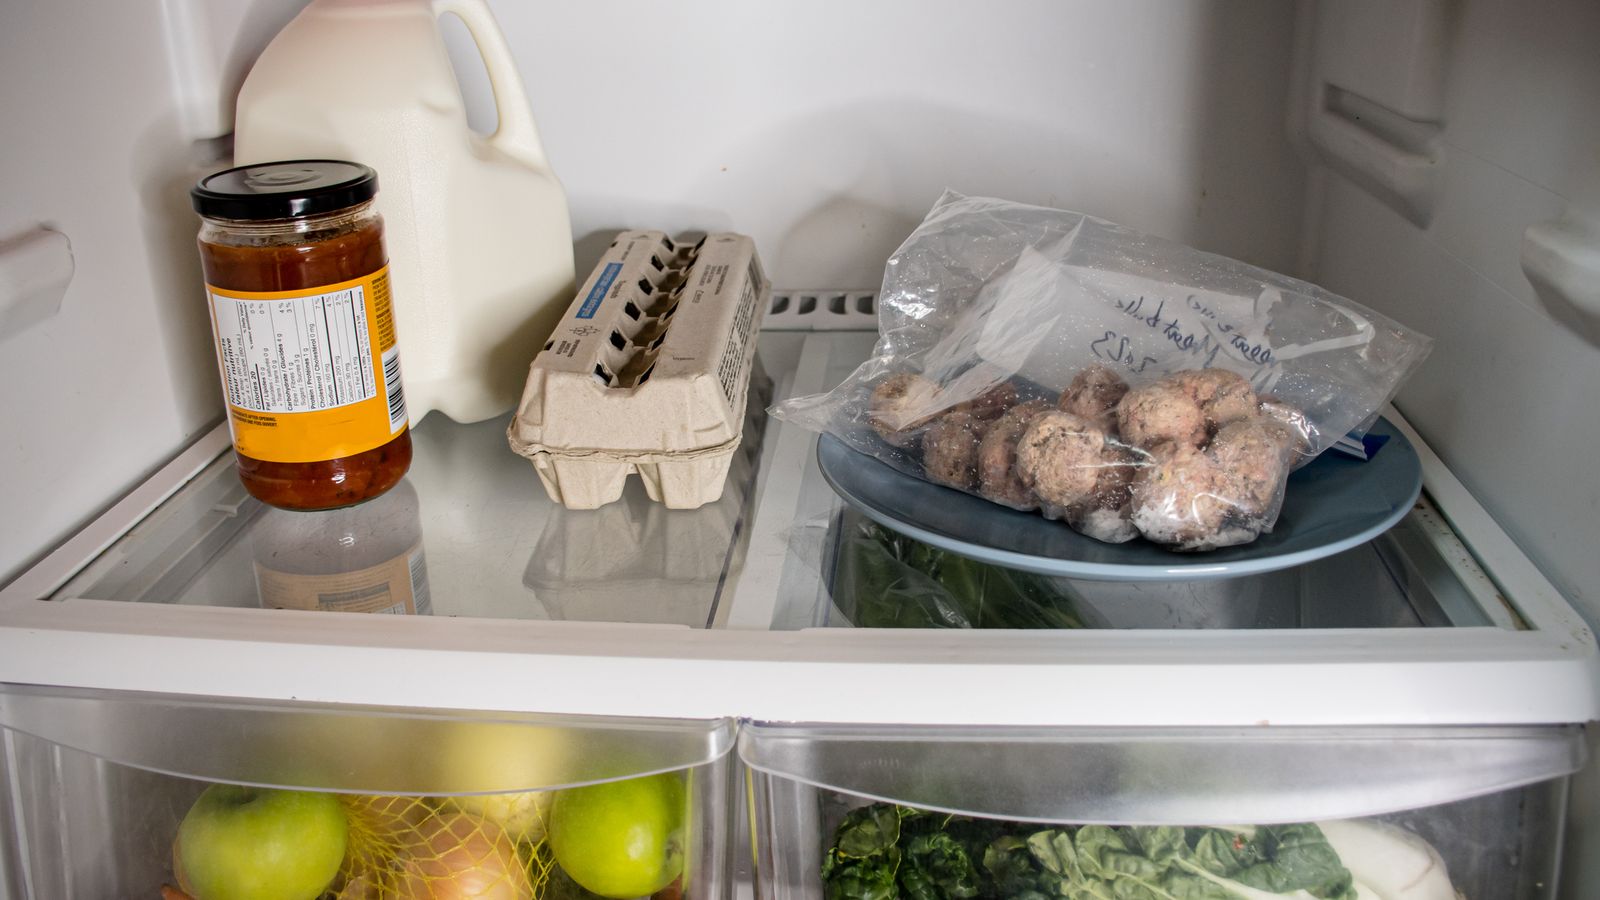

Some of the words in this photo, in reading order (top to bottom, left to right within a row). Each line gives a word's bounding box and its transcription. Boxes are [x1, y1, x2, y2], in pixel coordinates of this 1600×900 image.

[309, 323, 315, 332] mg
[227, 338, 236, 375] nutritive
[278, 344, 286, 369] Glucides
[310, 338, 320, 371] Cholestérol
[335, 356, 340, 364] mg
[345, 362, 350, 371] mg
[353, 356, 358, 365] mg
[250, 371, 256, 380] 20
[304, 358, 312, 384] Protéines
[324, 363, 330, 372] mg
[227, 365, 235, 403] Nutrition
[252, 382, 261, 409] Calories
[282, 374, 293, 411] Carbohydrate
[316, 376, 326, 408] Cholesterol
